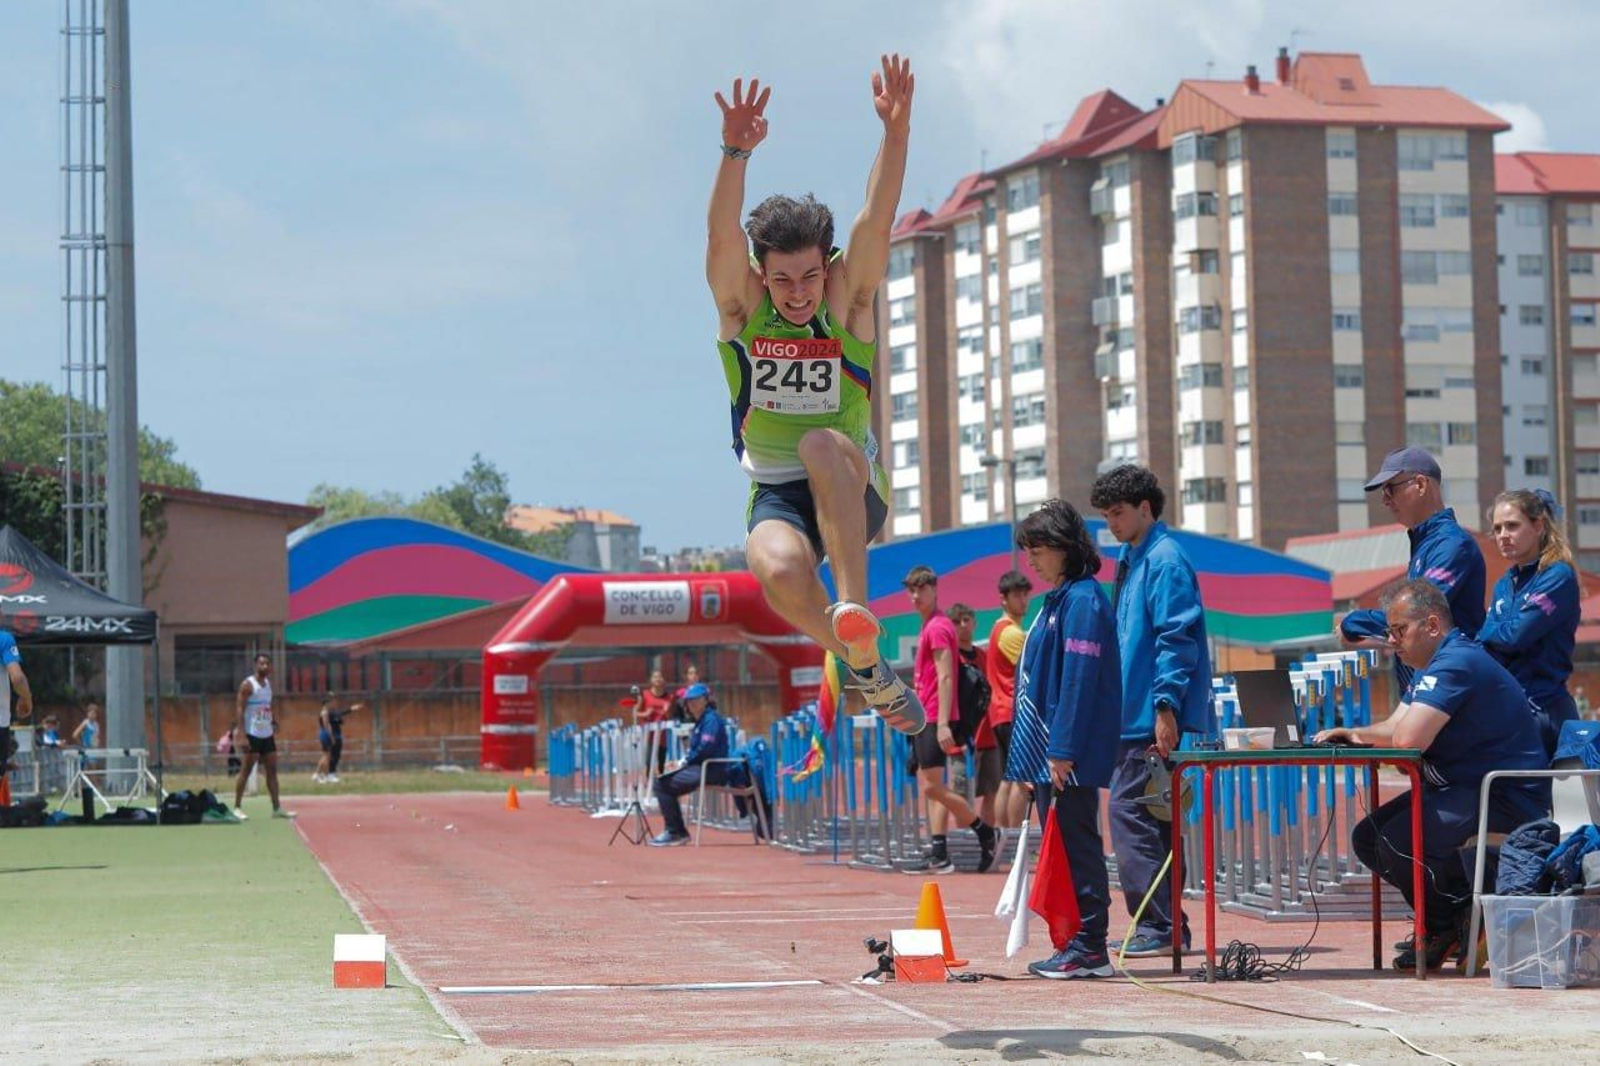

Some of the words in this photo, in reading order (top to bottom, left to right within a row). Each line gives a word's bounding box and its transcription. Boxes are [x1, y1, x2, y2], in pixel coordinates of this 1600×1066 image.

[755, 340, 838, 357] VIGO2024
[755, 359, 833, 393] 243
[610, 589, 684, 602] CONCELLO
[620, 604, 637, 616] DE
[643, 603, 676, 616] VIGO
[44, 616, 133, 633] 24MX
